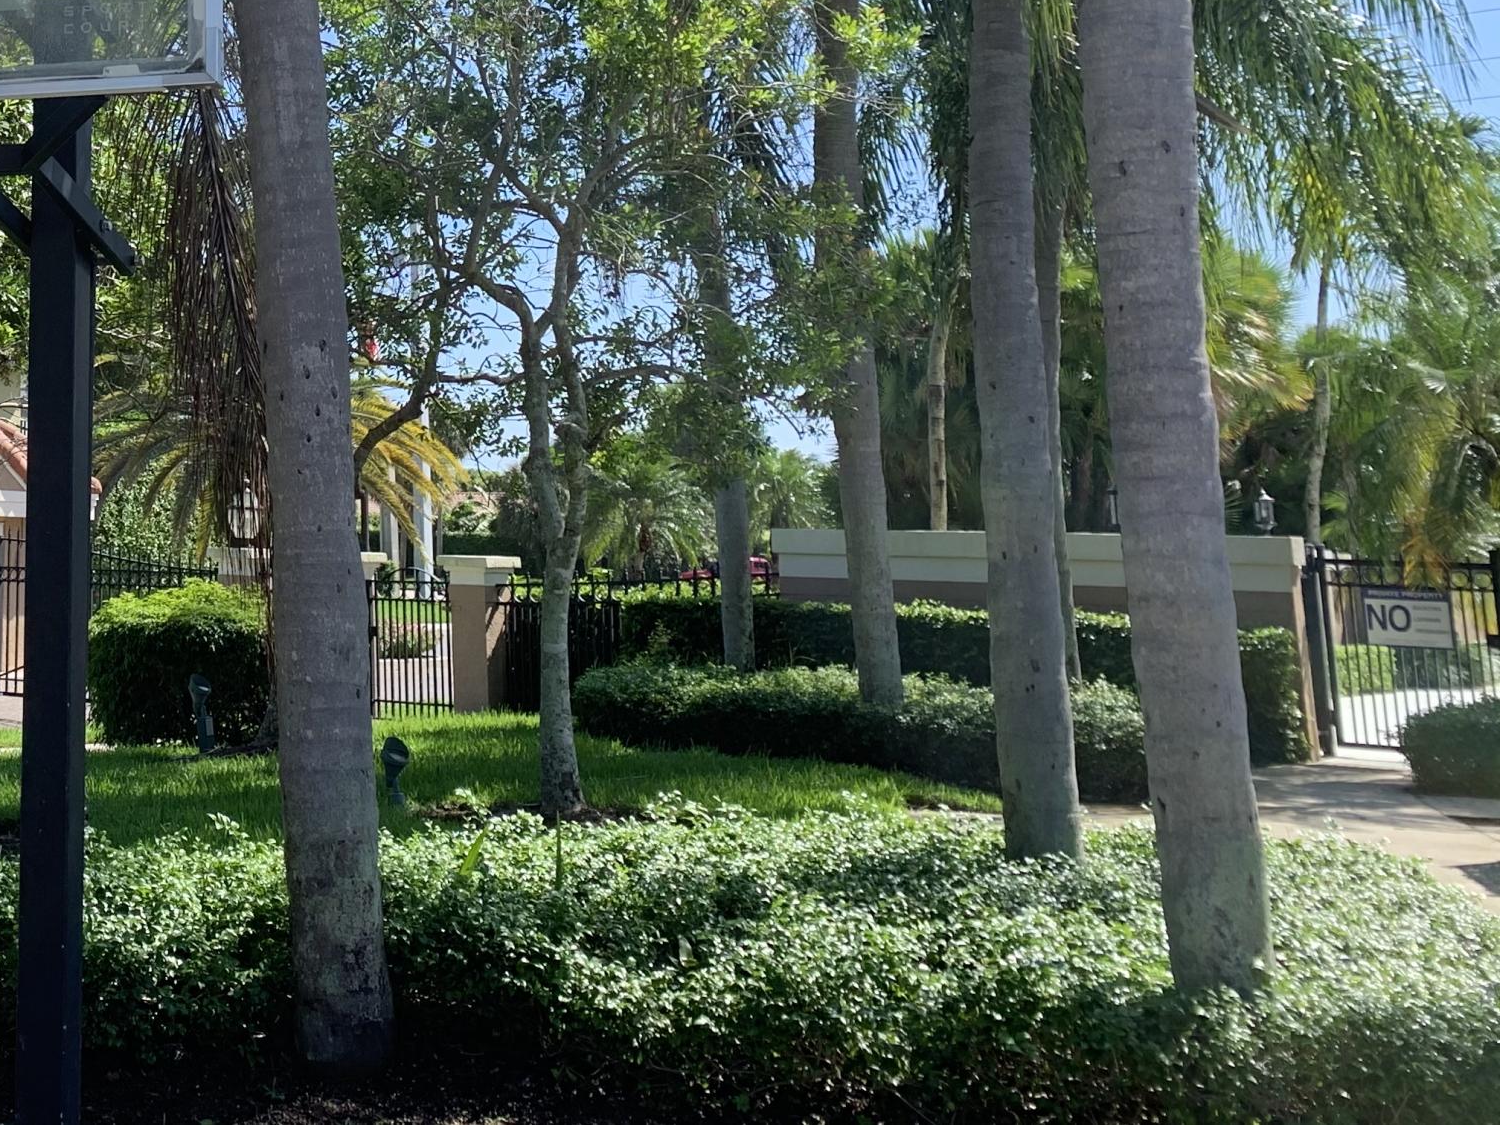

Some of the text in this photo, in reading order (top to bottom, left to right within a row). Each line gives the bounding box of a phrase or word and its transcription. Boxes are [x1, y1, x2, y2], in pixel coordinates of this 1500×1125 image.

[63, 1, 147, 17] SPORT
[63, 19, 147, 36] COURT
[1367, 589, 1444, 600] PATE PROPERTY
[1366, 604, 1411, 632] NO
